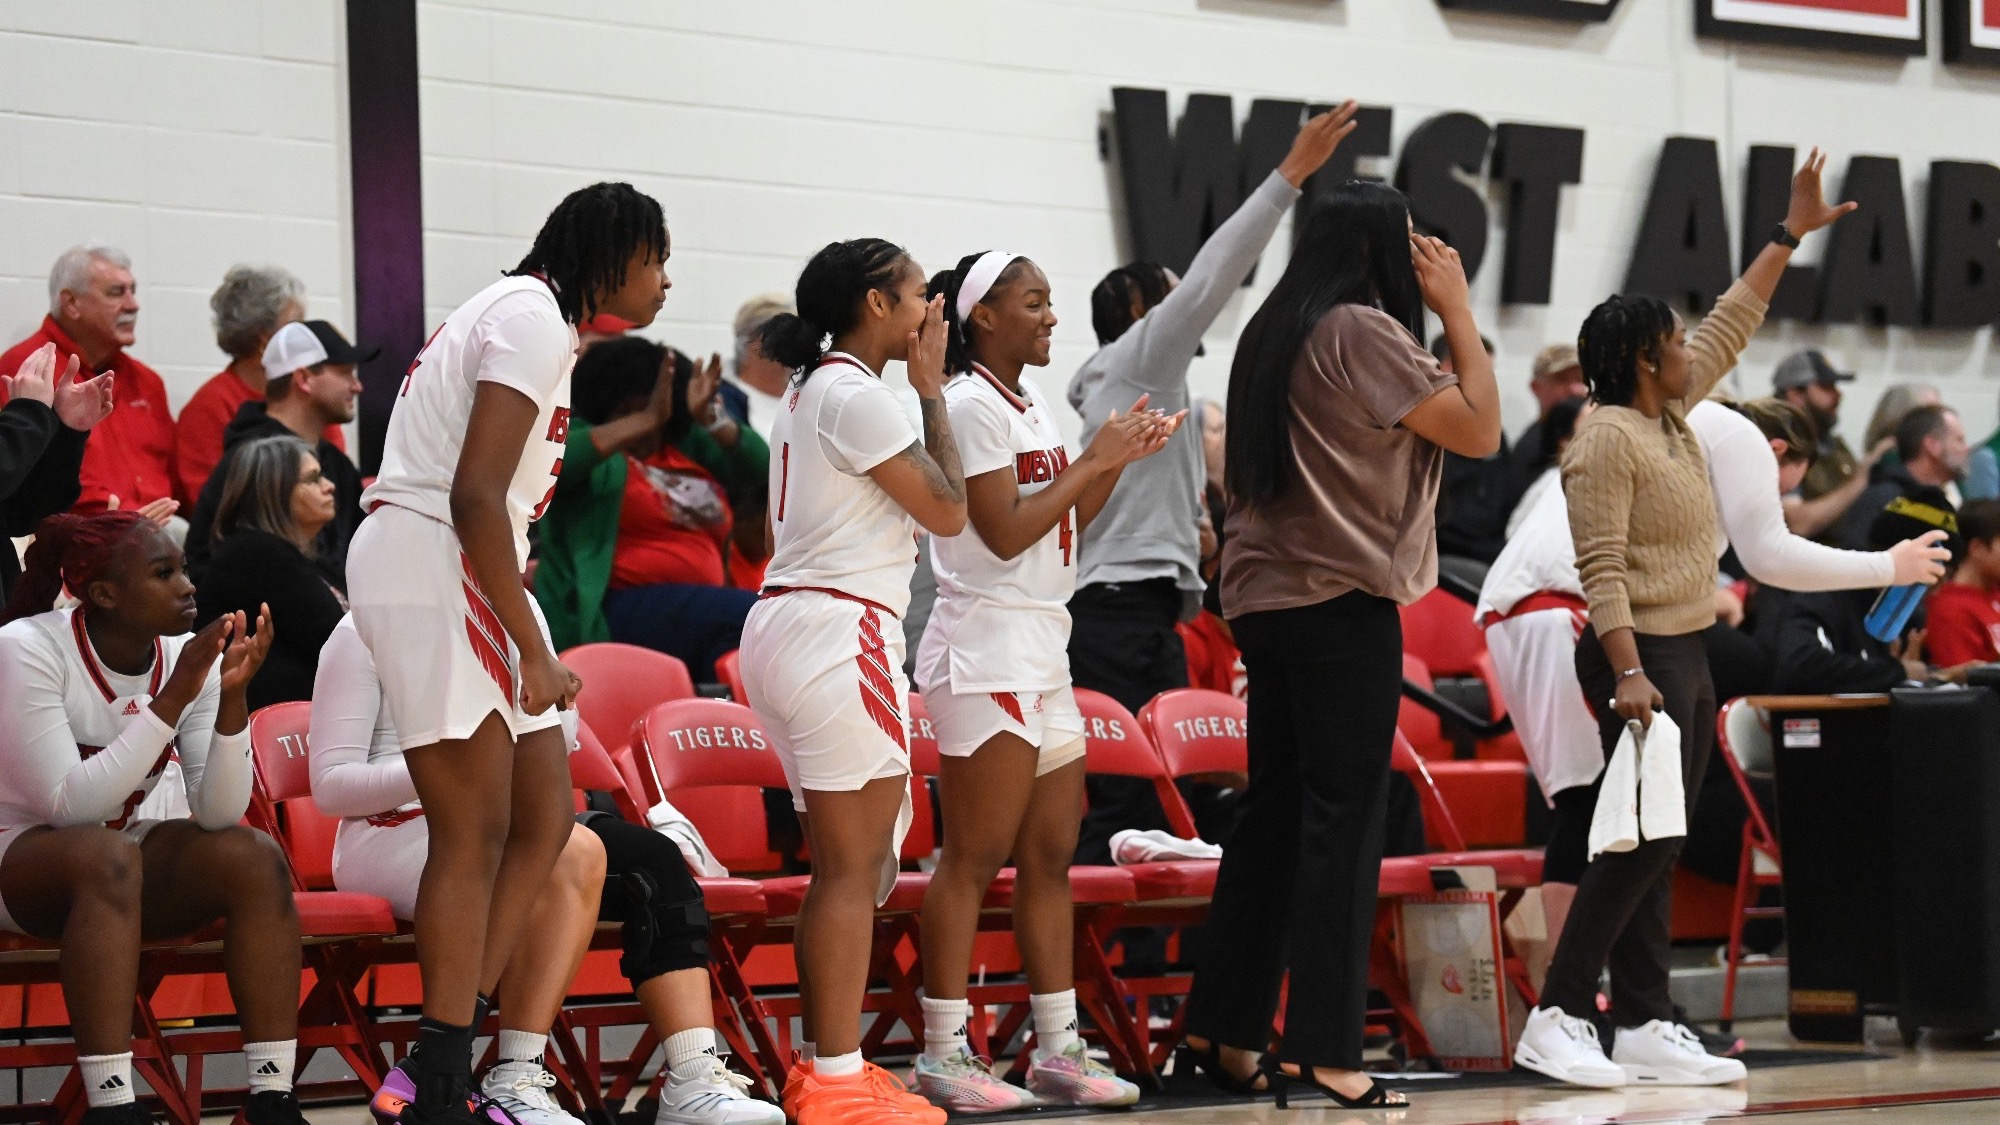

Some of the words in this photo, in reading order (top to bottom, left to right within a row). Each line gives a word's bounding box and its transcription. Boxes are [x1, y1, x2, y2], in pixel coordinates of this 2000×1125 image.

[777, 441, 789, 523] 1
[1058, 508, 1073, 567] 4
[276, 731, 310, 759] TI
[668, 726, 767, 751] TIGERS
